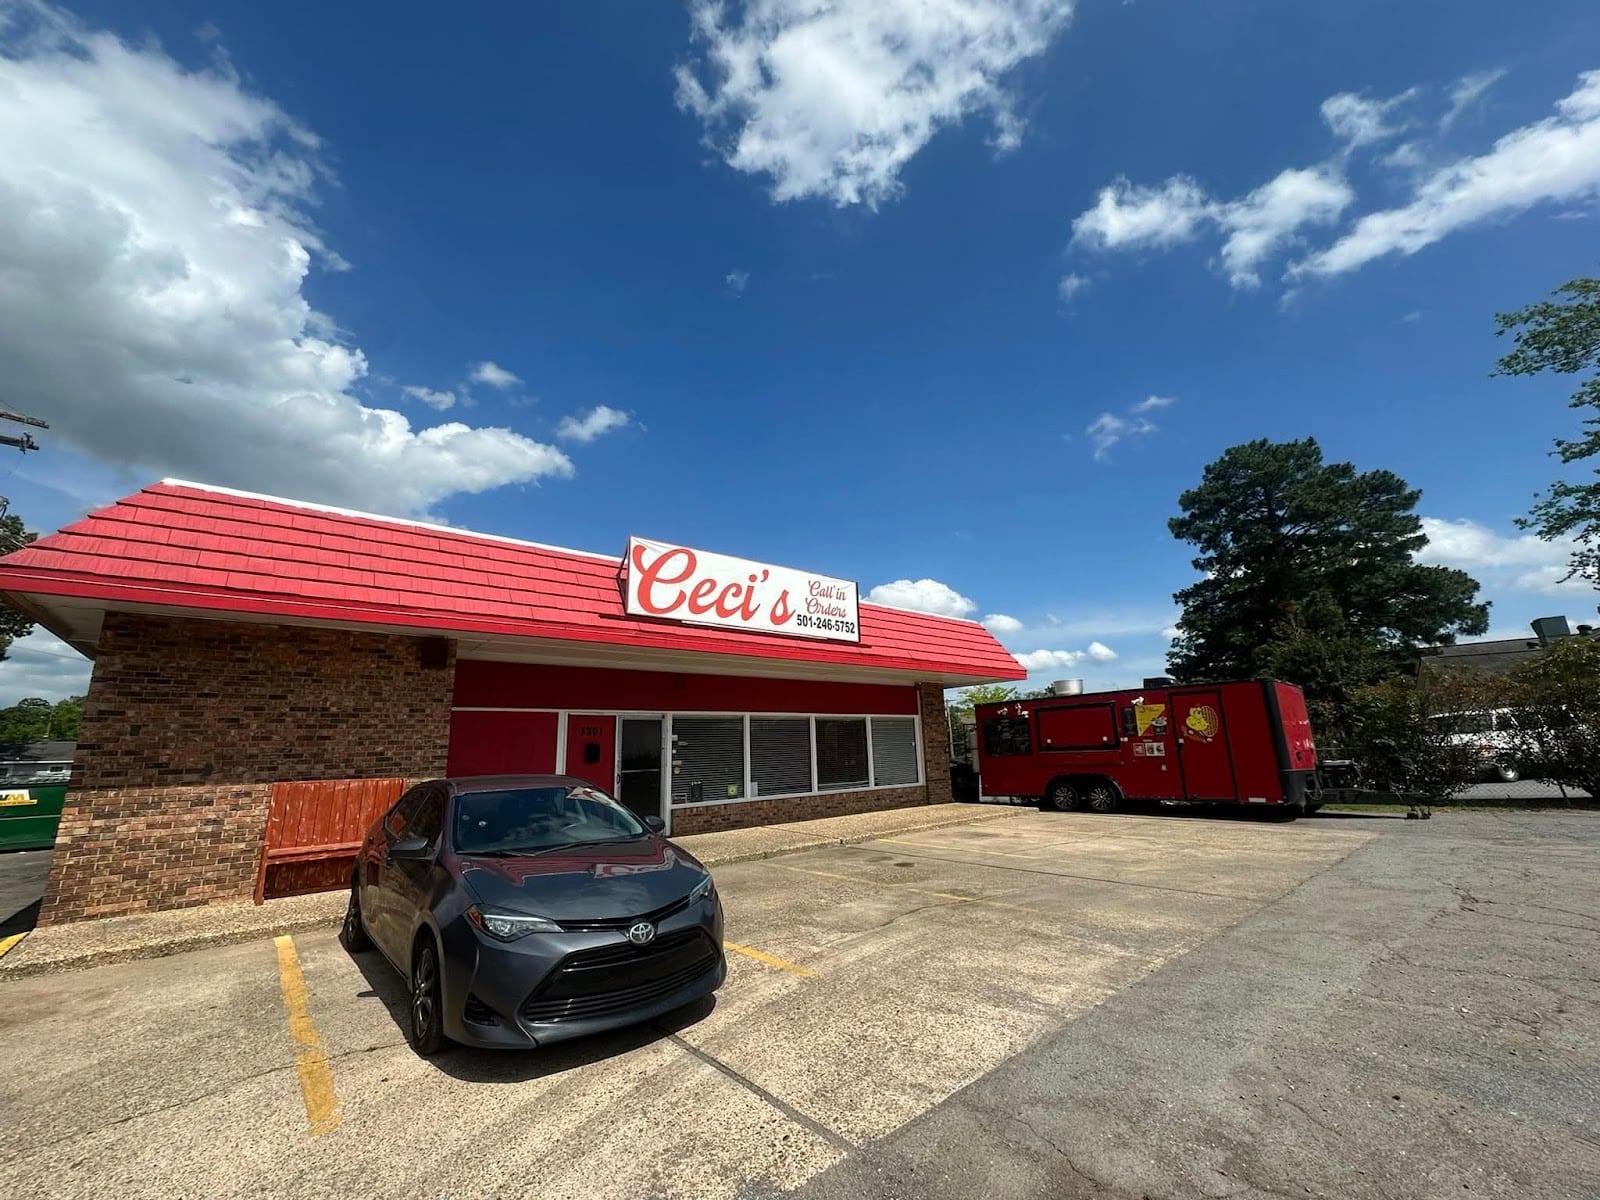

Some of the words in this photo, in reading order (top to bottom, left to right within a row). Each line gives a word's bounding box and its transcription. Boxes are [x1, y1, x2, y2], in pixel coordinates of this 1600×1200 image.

[632, 544, 796, 625] Ceci's
[805, 597, 848, 618] Orders
[797, 614, 856, 634] 501-246-5752
